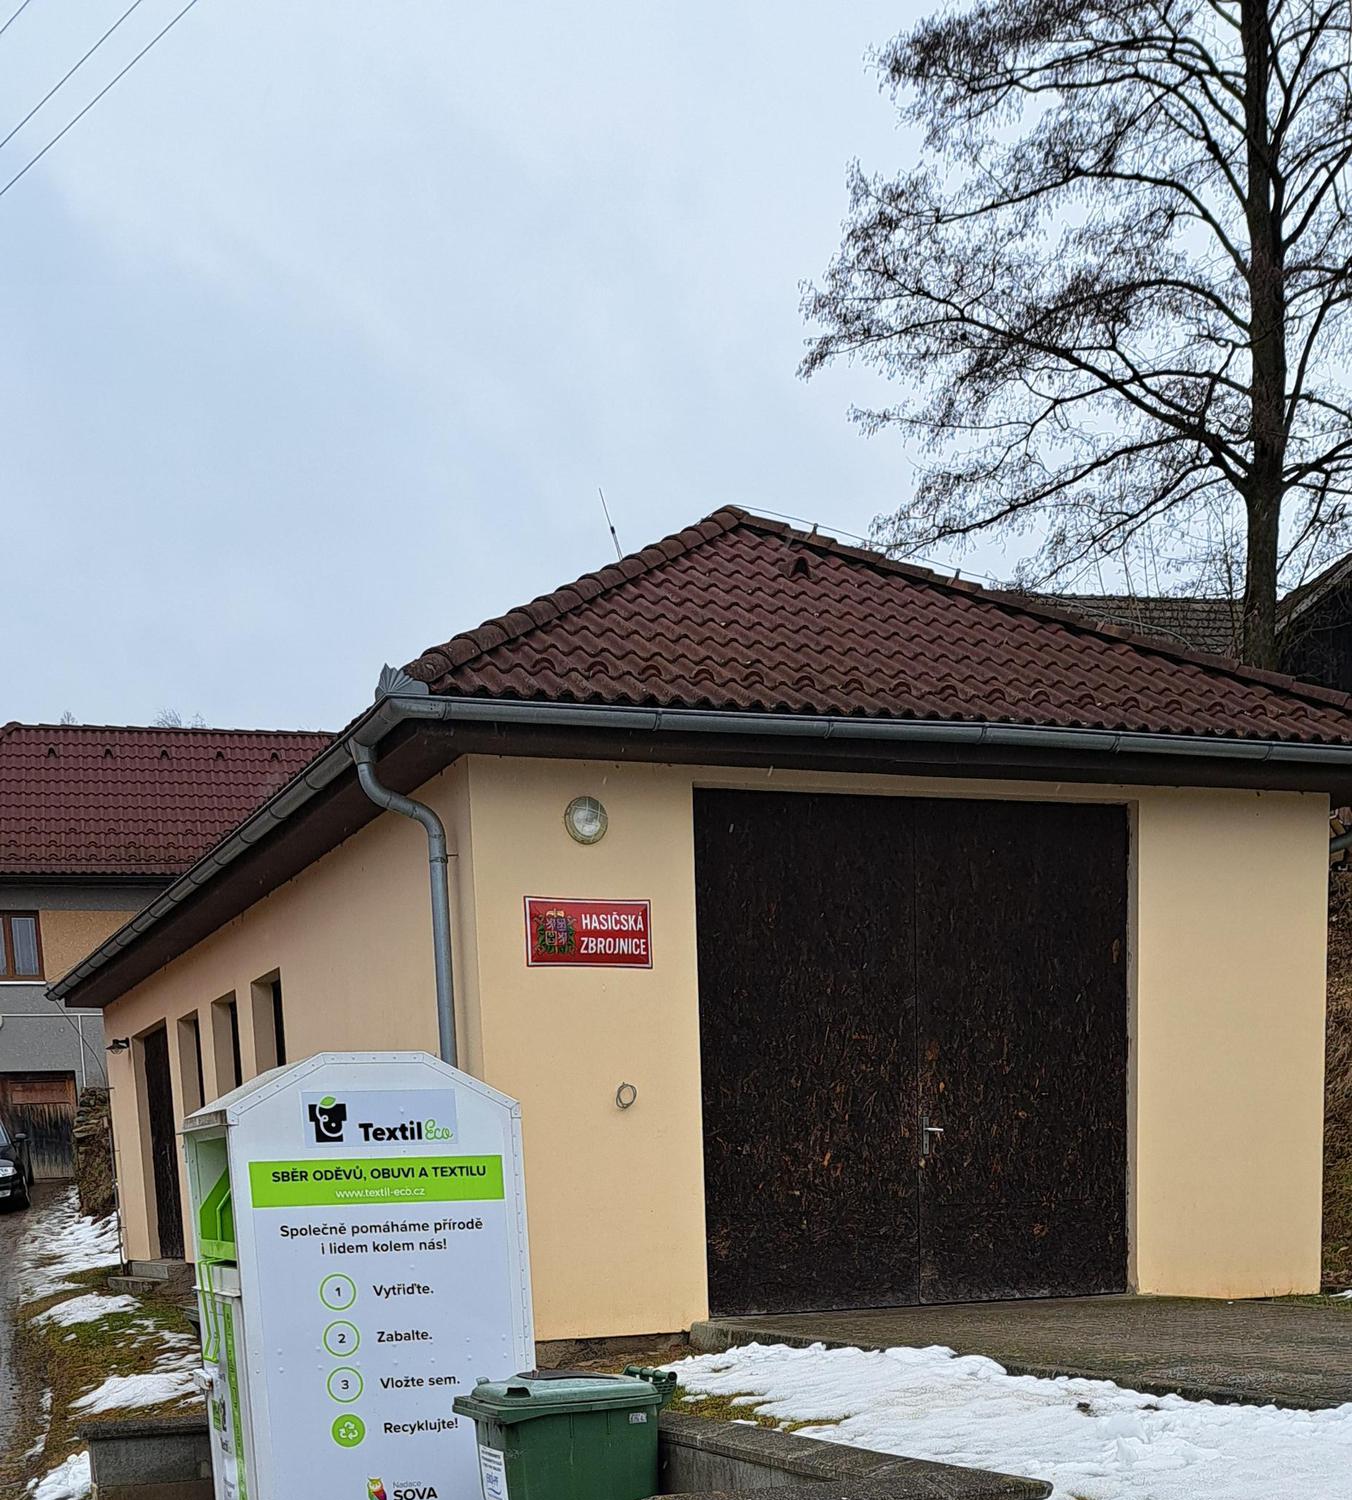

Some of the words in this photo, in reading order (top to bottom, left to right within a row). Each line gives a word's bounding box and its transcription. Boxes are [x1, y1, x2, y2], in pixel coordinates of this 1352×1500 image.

[582, 912, 644, 931] HASIČSKÁ
[580, 937, 647, 955] ZBROJNICE
[272, 1167, 308, 1182] SBĚR
[313, 1165, 367, 1182] ODĚVŮ,
[370, 1167, 415, 1179] OBUVI
[418, 1166, 429, 1177] A
[432, 1165, 486, 1177] TEXTILU
[335, 1187, 426, 1198] www.textil-eco.cz
[280, 1222, 347, 1239] Společně
[351, 1220, 429, 1237] pomáháme
[434, 1217, 483, 1234] přírodě
[321, 1242, 325, 1254] i
[329, 1242, 368, 1254] lidem
[372, 1240, 414, 1253] kolem
[419, 1238, 447, 1250] nás!
[335, 1287, 341, 1297] 1
[373, 1283, 434, 1299] Vytřiďte.
[337, 1333, 346, 1344] 2
[377, 1330, 432, 1343] Zabalte.
[341, 1380, 349, 1390] 3
[380, 1376, 424, 1389] Vložte
[428, 1376, 460, 1386] sem.
[384, 1418, 458, 1435] Recyklujte!
[393, 1480, 421, 1489] Nadace
